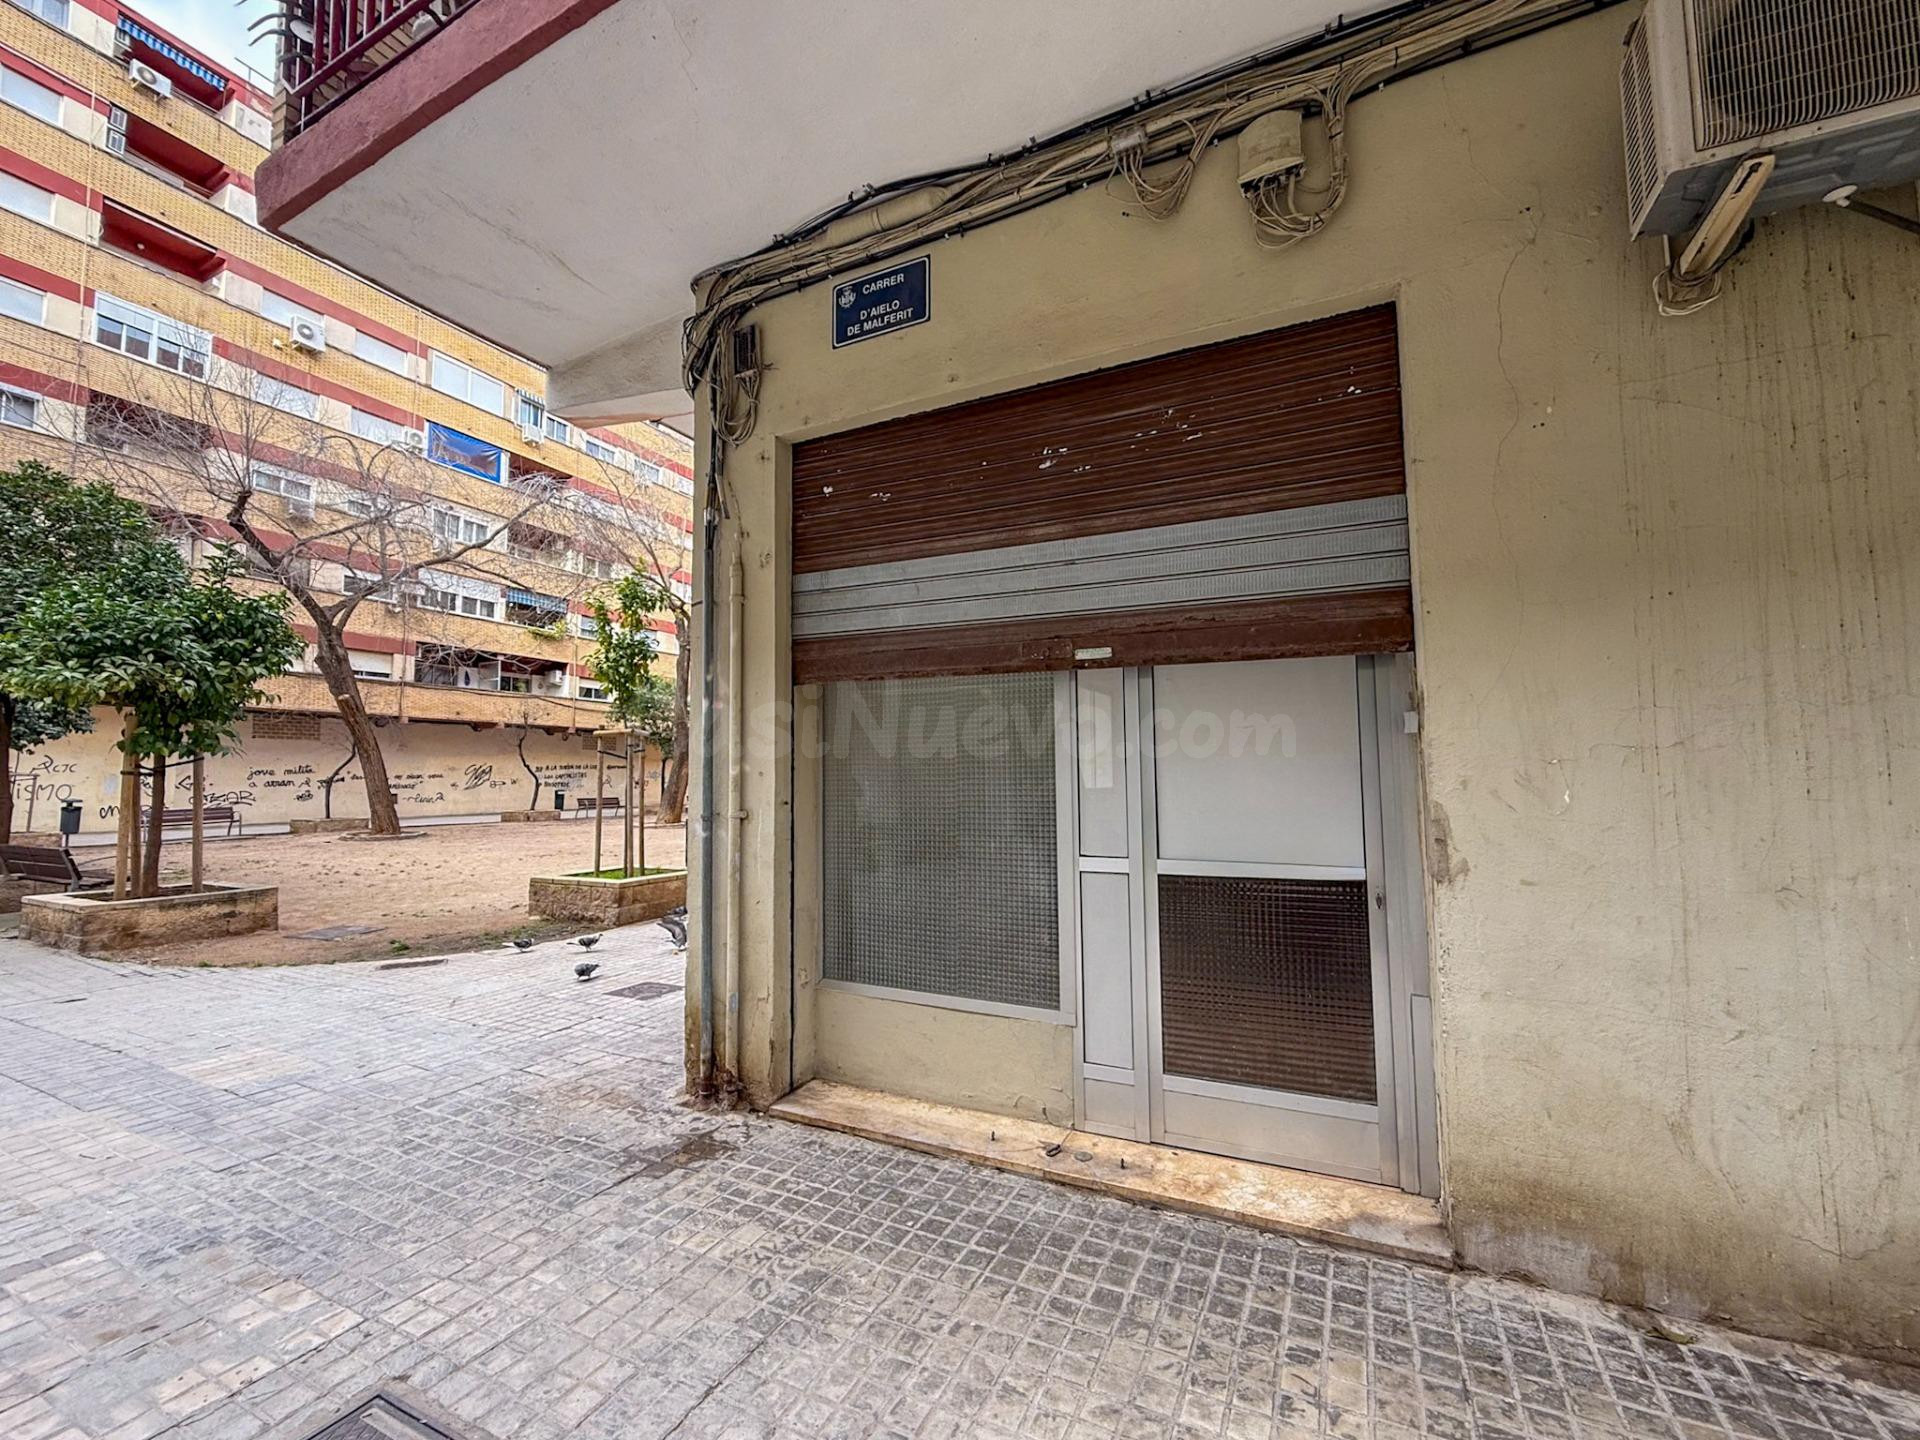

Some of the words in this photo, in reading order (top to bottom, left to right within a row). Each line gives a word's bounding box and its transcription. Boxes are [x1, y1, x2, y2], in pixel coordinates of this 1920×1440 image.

[862, 273, 905, 294] CARRER
[860, 299, 900, 320] D'AIELO
[847, 324, 861, 336] DE
[863, 307, 914, 331] MALFERIT
